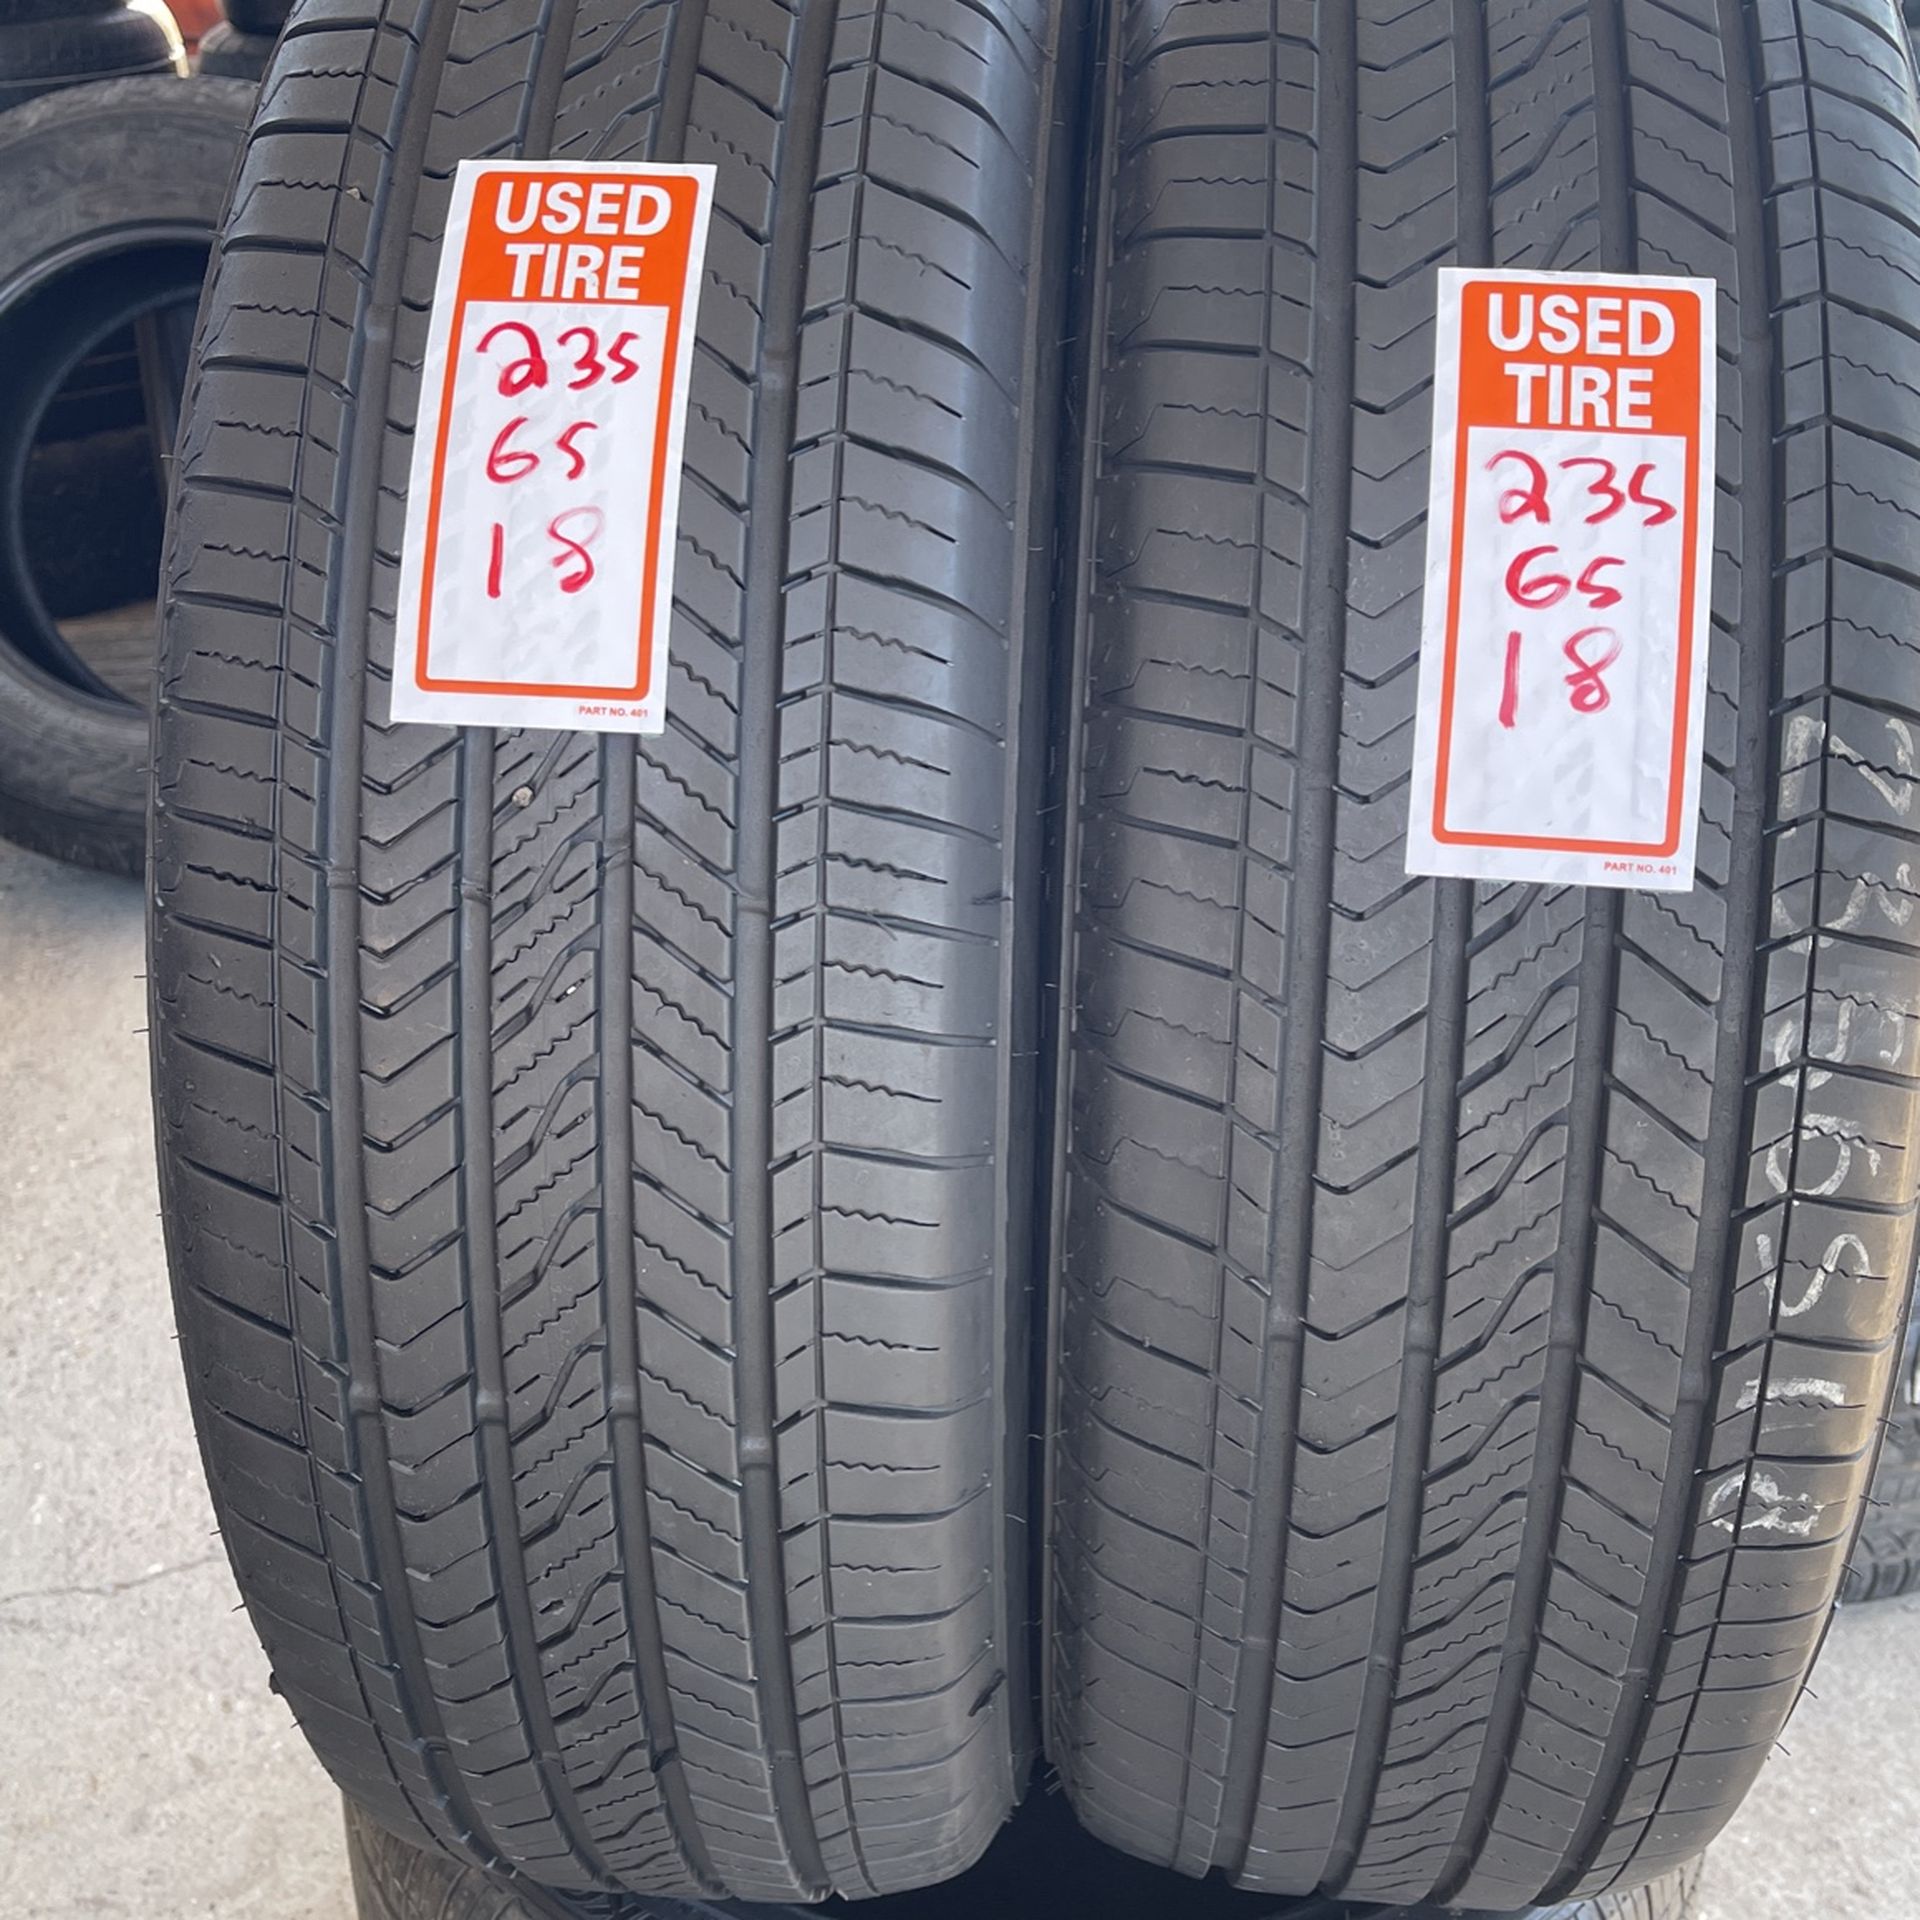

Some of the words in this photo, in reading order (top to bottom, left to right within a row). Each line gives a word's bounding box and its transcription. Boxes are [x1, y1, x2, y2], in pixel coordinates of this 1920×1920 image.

[493, 181, 672, 236] USED
[504, 243, 645, 301] TIRE
[1487, 292, 1675, 357] USED
[475, 320, 641, 397] 235
[1502, 362, 1654, 430] TIRE
[485, 416, 598, 484] 65
[1484, 449, 1678, 527] 235
[1504, 545, 1626, 610] 65
[578, 705, 607, 716] PART
[609, 707, 628, 717] NO.
[1603, 861, 1633, 872] PART
[1636, 863, 1657, 873] NO.
[1659, 865, 1677, 875] 401
